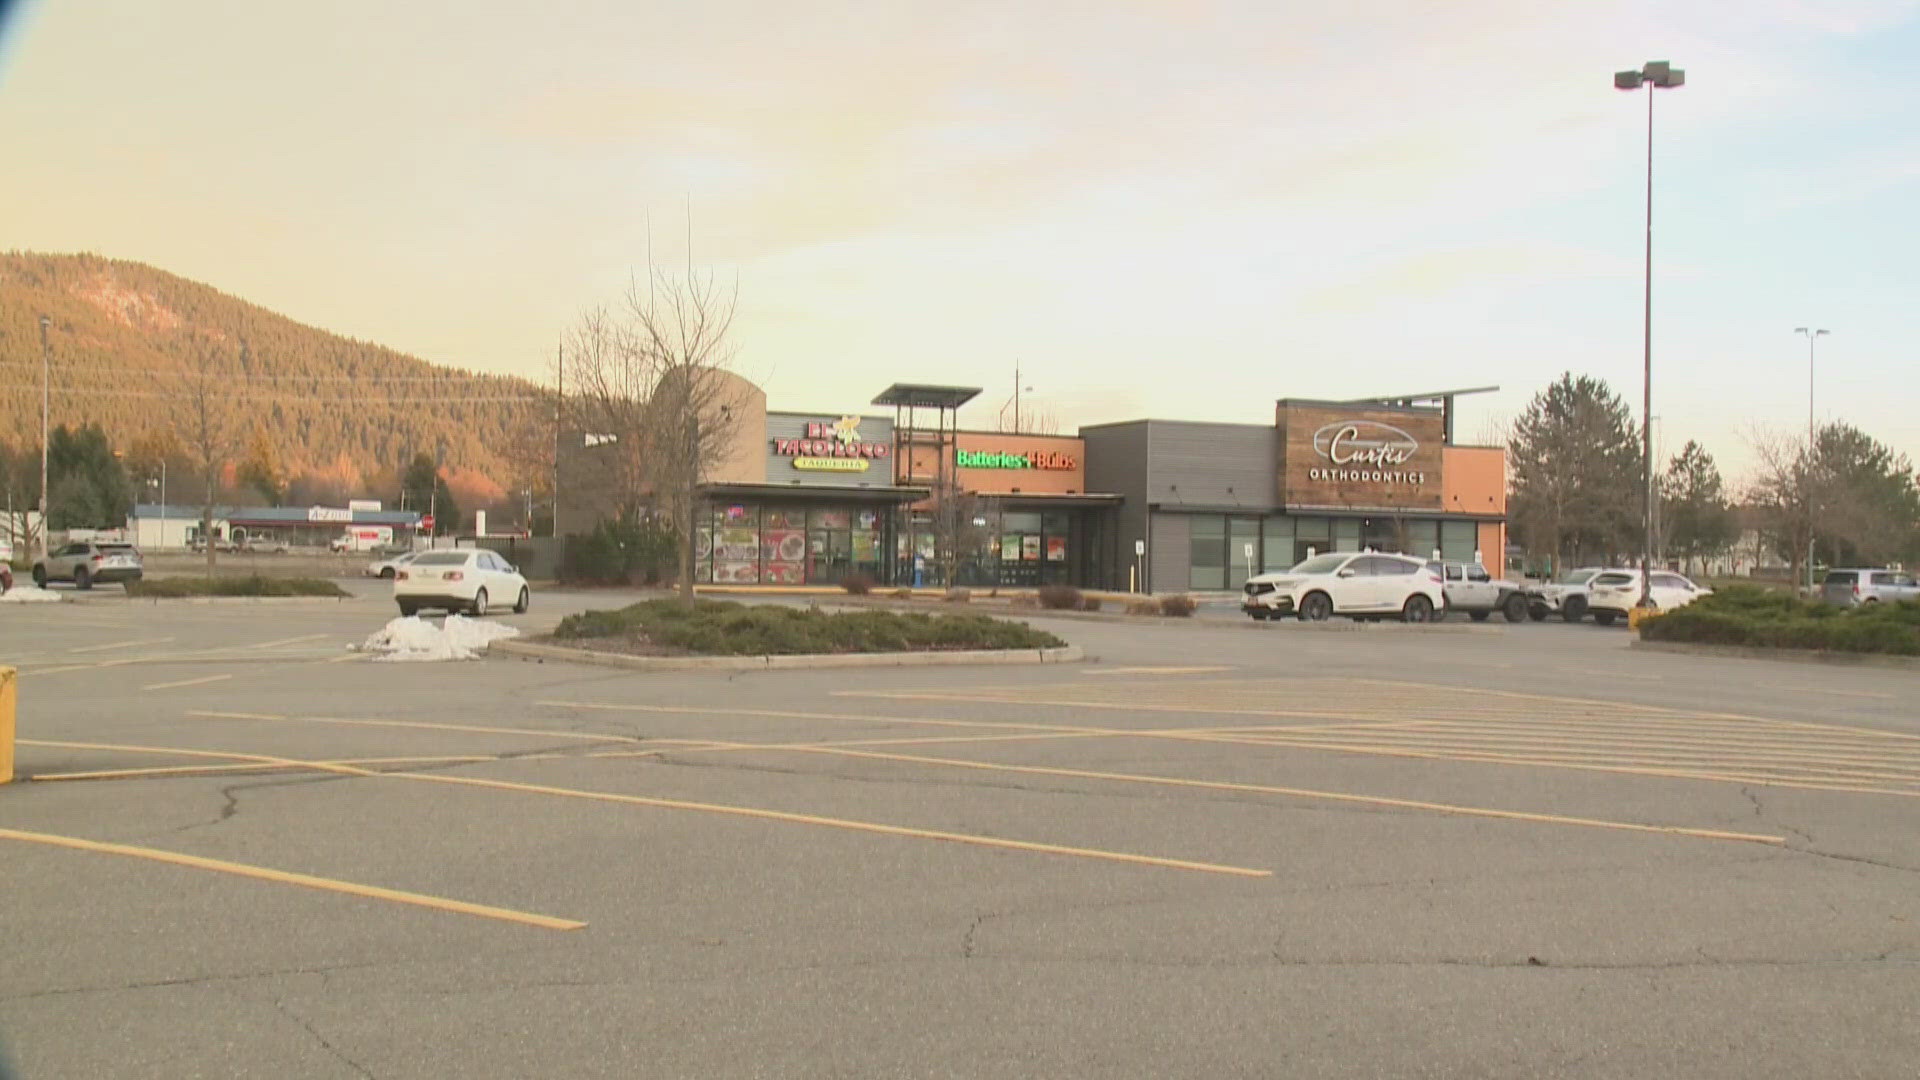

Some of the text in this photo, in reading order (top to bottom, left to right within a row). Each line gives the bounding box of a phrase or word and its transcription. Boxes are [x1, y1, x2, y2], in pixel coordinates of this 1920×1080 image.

[776, 439, 890, 457] TACO LOCO
[1331, 426, 1407, 469] Curtis
[957, 450, 1022, 467] Batteries
[1037, 451, 1076, 469] Bulbs
[1310, 468, 1425, 484] ORTHODONTICS
